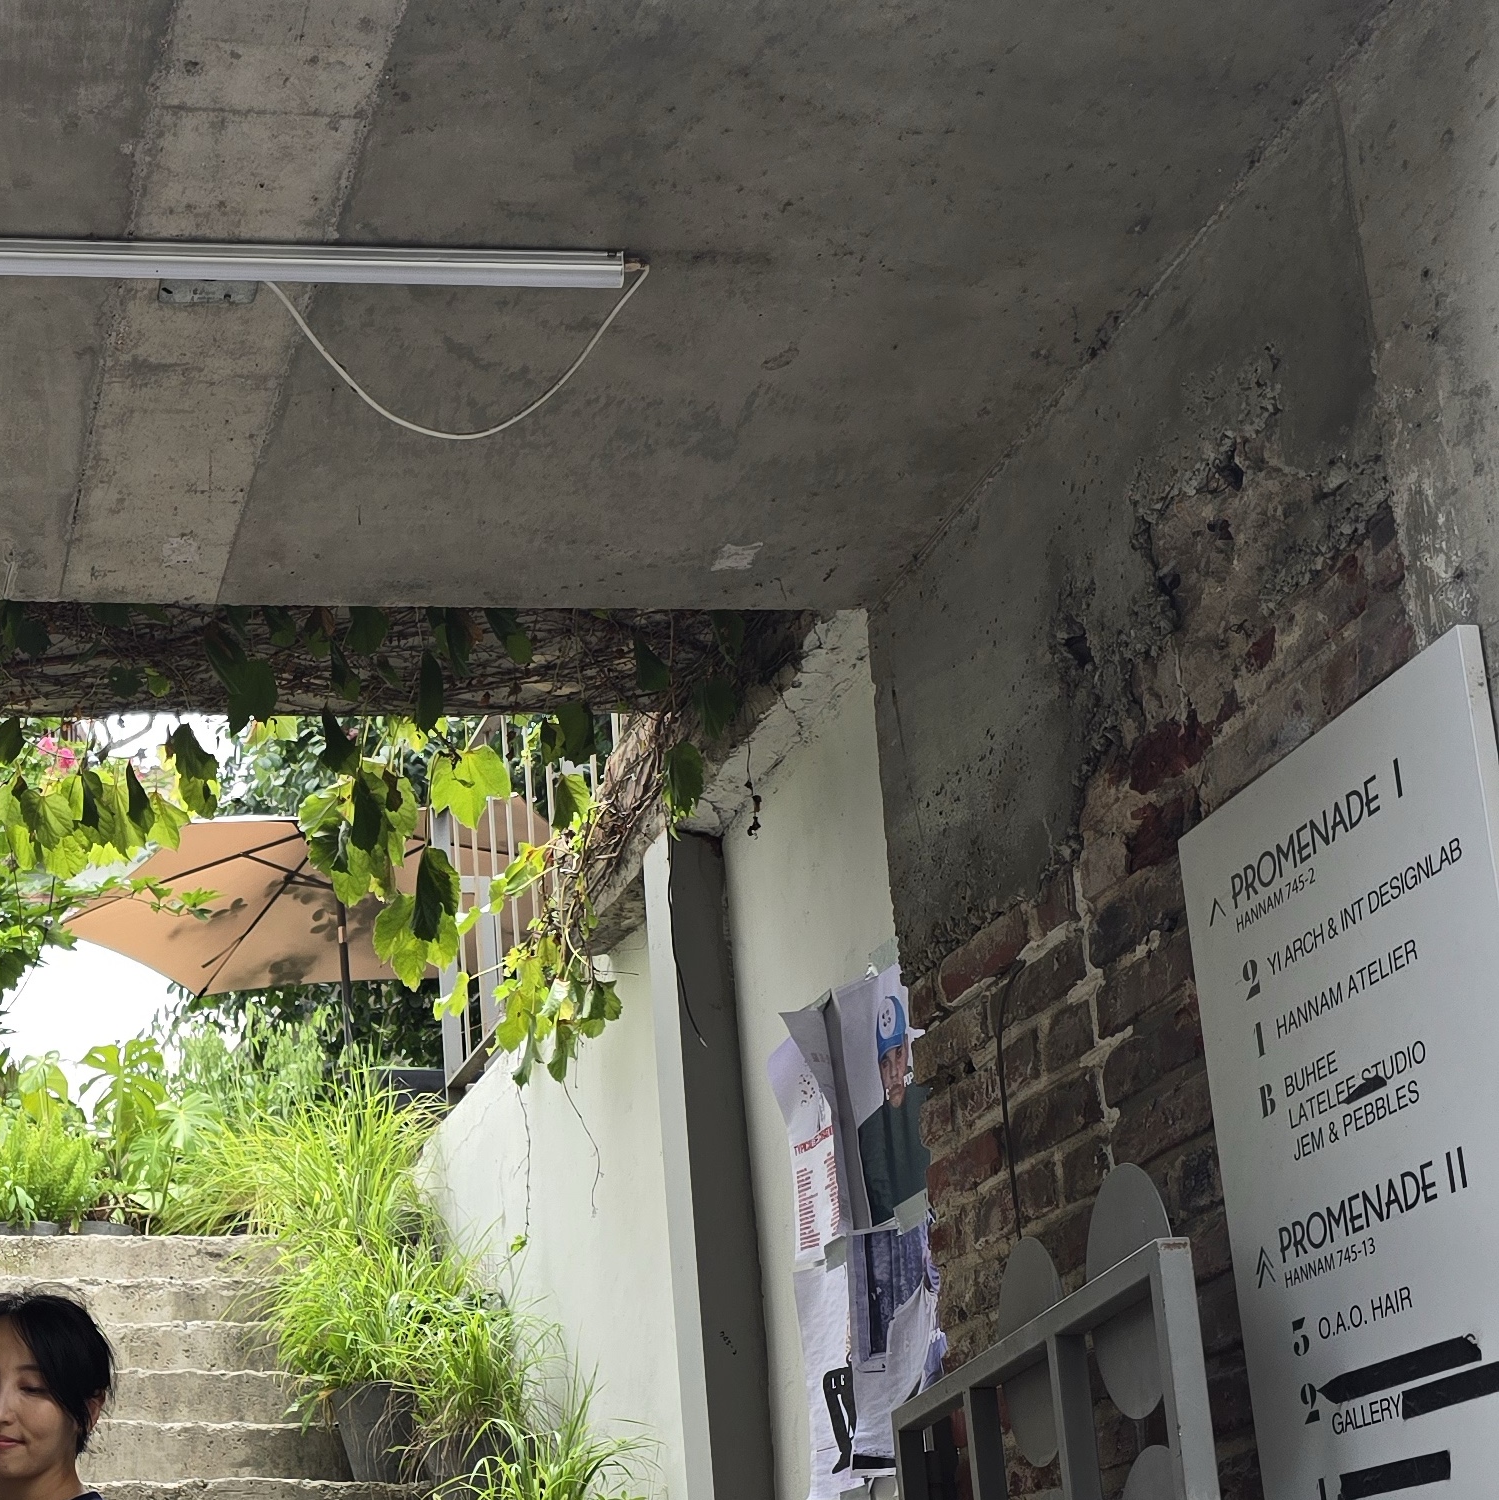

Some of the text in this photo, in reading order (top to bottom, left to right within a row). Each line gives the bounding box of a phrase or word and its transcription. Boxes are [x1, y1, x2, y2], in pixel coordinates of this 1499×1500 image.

[1230, 774, 1381, 909] PROMENADE
[1235, 867, 1316, 933] HANNAM 745-2
[1242, 959, 1261, 1001] 2
[1284, 923, 1325, 968] ARCH
[1327, 917, 1339, 940] &
[1340, 897, 1364, 932] INT
[1367, 837, 1463, 915] DESIGNLAB
[1275, 981, 1343, 1039] HANNAM
[1347, 939, 1418, 999] ATELIER
[1284, 1050, 1338, 1098] BUHEE
[1361, 1040, 1426, 1081] STUDIO
[1257, 1083, 1276, 1119] B
[1294, 1080, 1420, 1161] JEM & PEBBLES
[1278, 1146, 1468, 1263] PROMENADE II
[1284, 1237, 1376, 1288] HANNAM 745-13
[1318, 1304, 1368, 1340] O.A.O.
[1370, 1286, 1413, 1321] HAIR
[1300, 1383, 1320, 1425] 2
[1331, 1393, 1402, 1435] GALLERY
